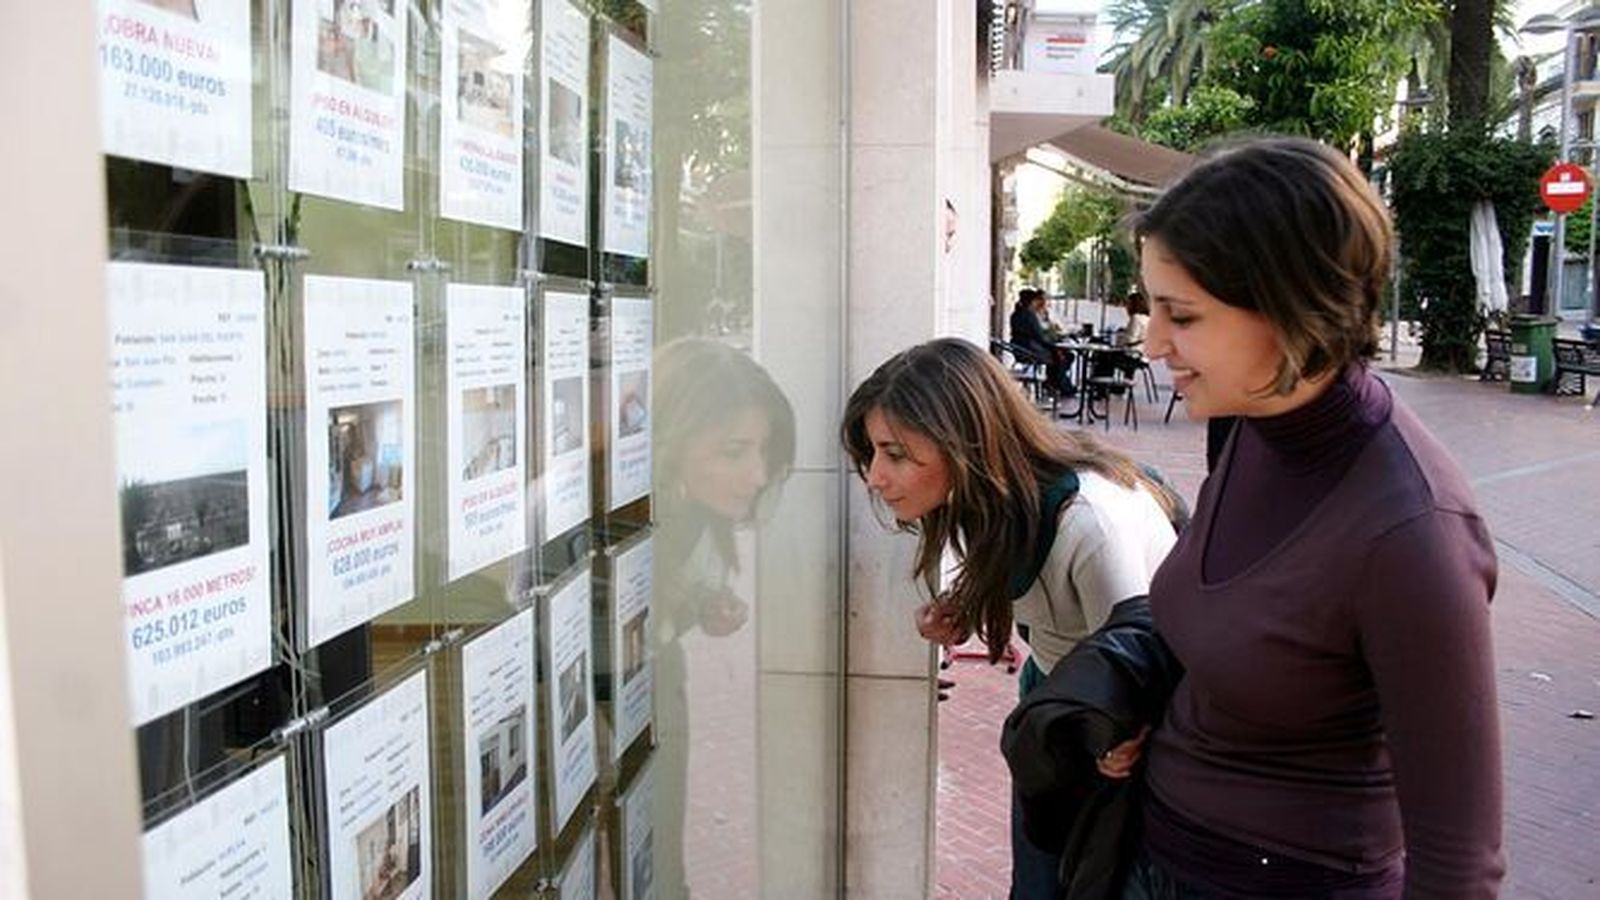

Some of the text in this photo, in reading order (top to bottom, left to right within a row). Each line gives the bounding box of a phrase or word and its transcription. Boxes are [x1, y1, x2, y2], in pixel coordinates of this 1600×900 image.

[177, 69, 226, 97] euros
[130, 595, 164, 618] INCA
[132, 596, 247, 650] 625.012 euros
